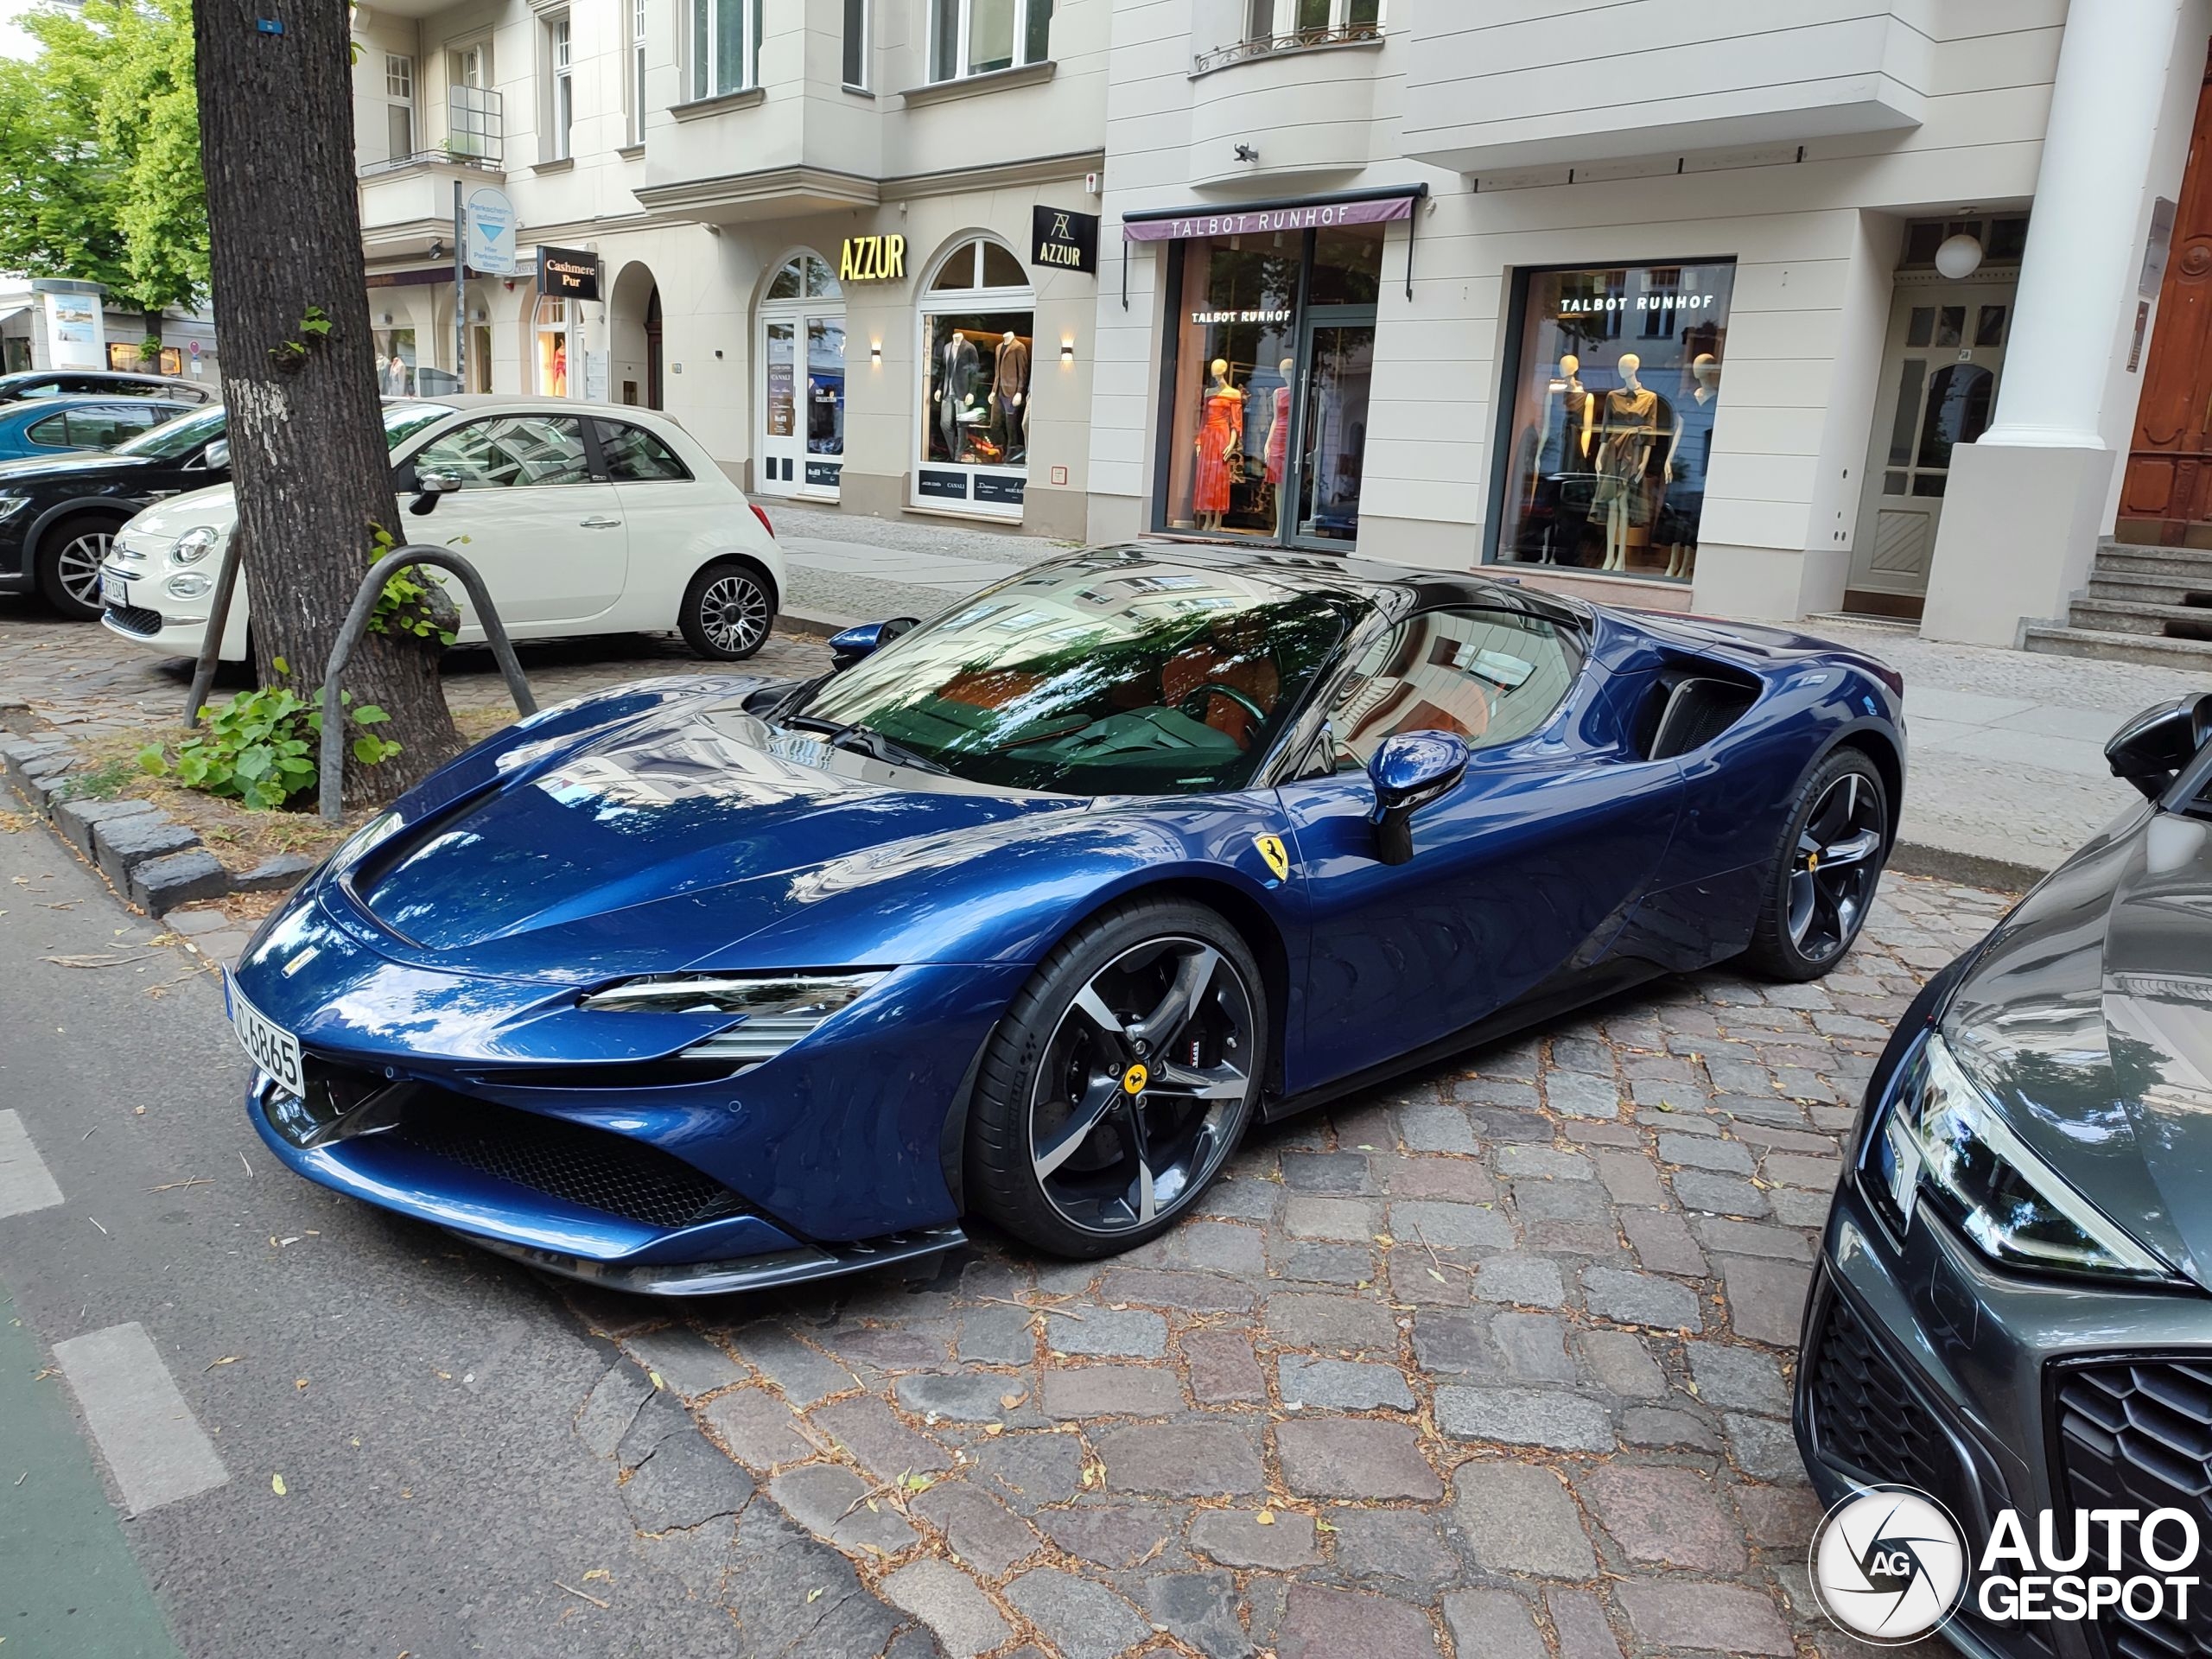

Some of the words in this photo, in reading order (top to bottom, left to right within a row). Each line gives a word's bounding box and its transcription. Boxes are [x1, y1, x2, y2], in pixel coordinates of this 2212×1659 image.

[1172, 216, 1246, 237] TALBOT
[1258, 207, 1349, 231] RUNHOF
[839, 234, 905, 281] AZZUR
[1039, 242, 1080, 266] AZZUR
[546, 259, 595, 276] Cashmere
[562, 275, 581, 287] Pur
[1560, 297, 1628, 312] TALBOT
[1637, 295, 1713, 310] RUNHOF
[1192, 312, 1237, 323] TALBOT
[1241, 310, 1291, 322] RUNHOF
[250, 1015, 297, 1086] 6865
